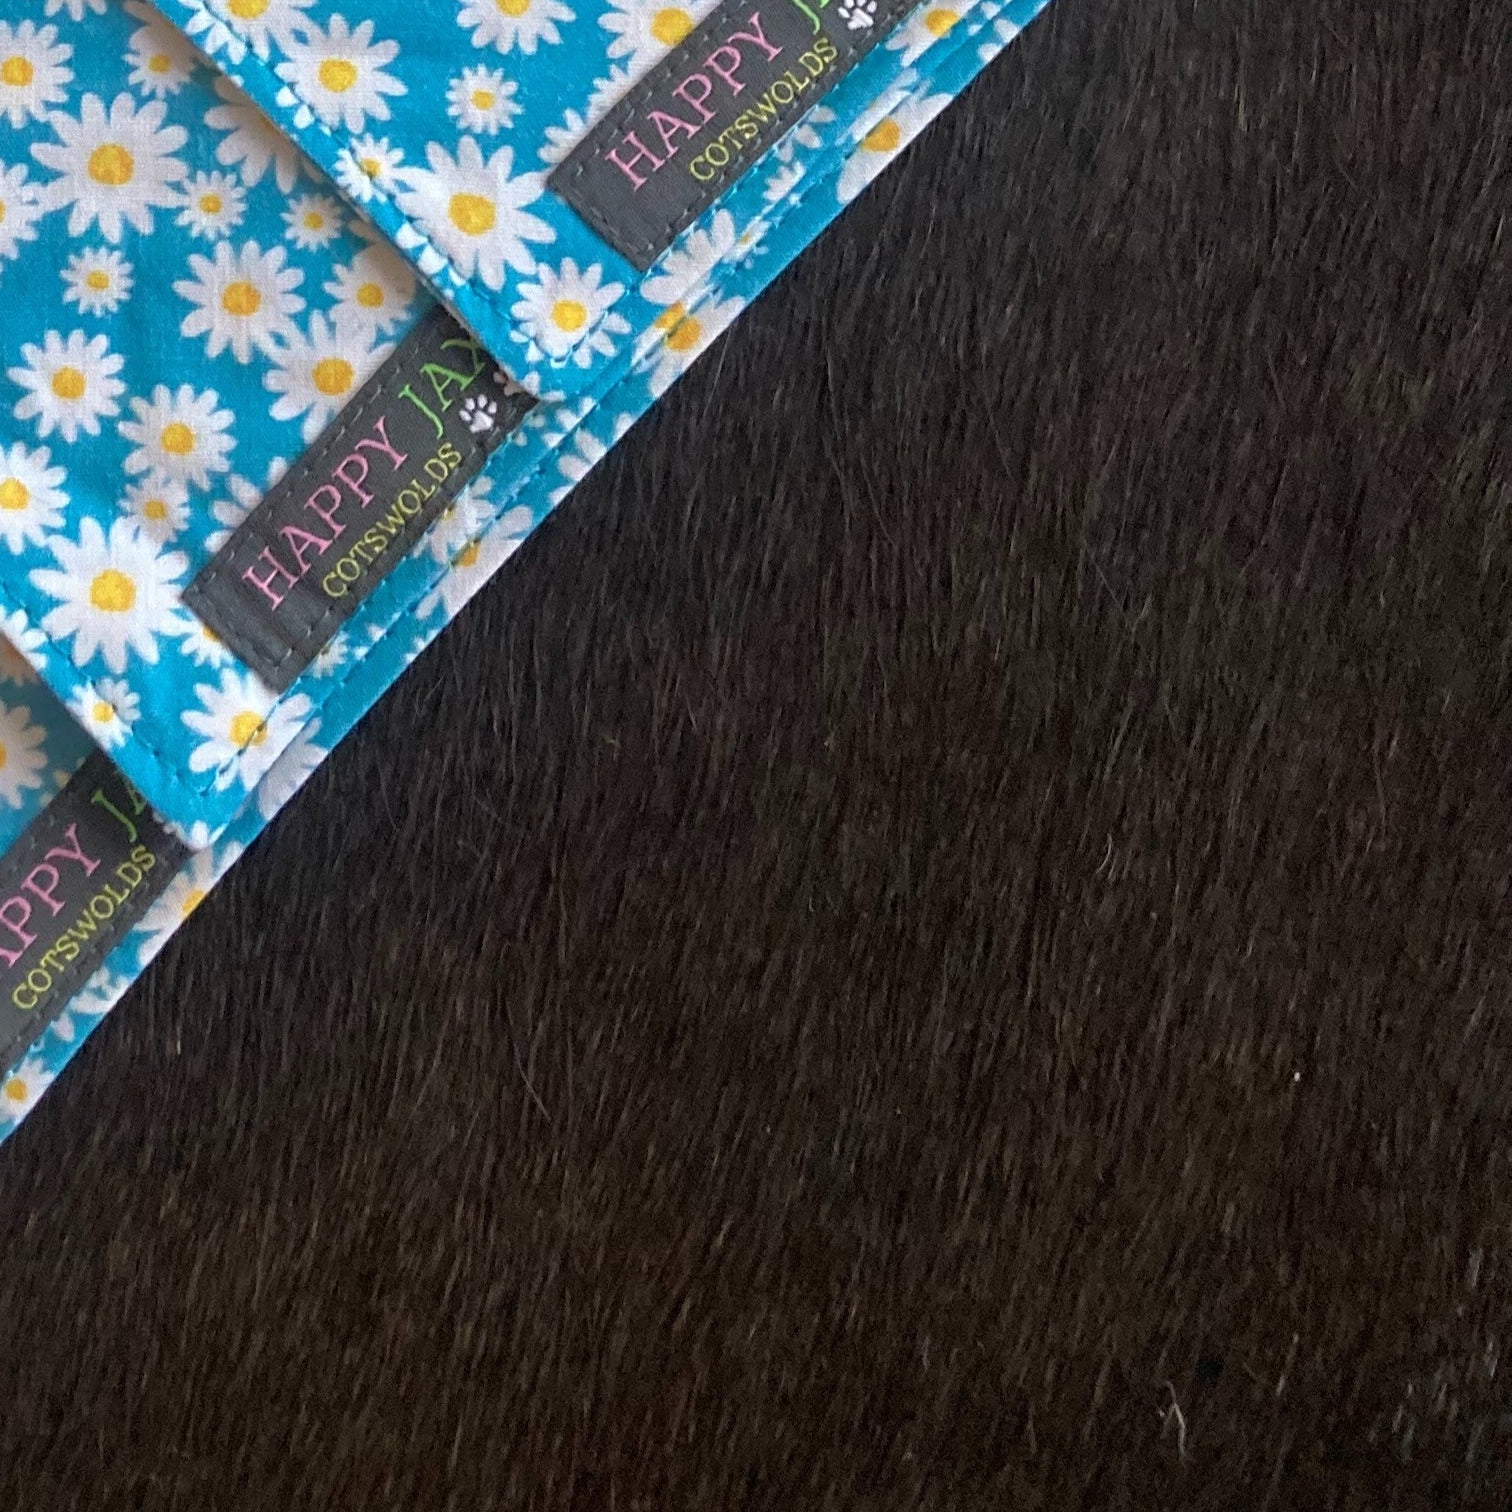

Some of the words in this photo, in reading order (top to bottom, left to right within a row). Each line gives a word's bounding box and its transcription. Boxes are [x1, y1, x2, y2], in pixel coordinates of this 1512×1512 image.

[604, 11, 783, 190] HAPPY
[689, 36, 838, 181] COTSWOLDS
[242, 416, 408, 611] HAPPY
[322, 441, 463, 598] COTSWOLDS
[11, 844, 156, 1009] COTSWOLDS
